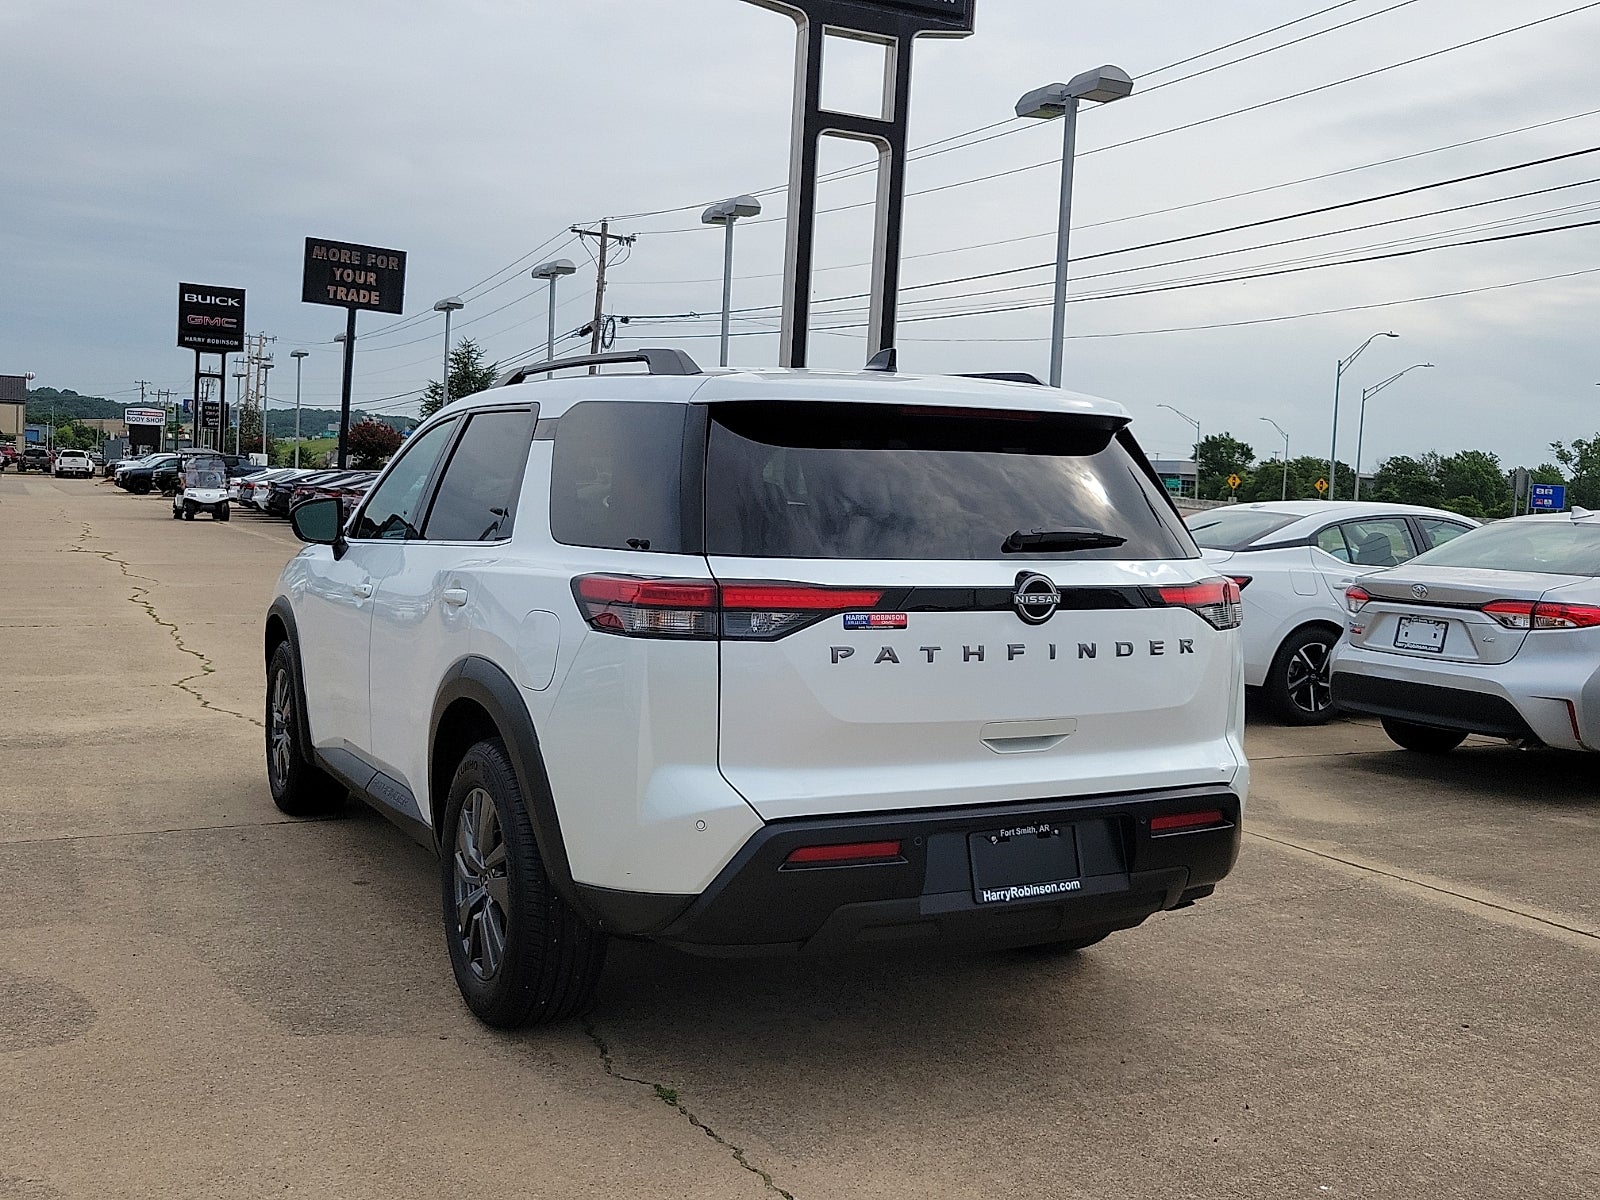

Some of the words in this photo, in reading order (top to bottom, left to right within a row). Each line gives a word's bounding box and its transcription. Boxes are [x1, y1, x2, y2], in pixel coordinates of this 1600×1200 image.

[312, 245, 361, 265] MORE
[366, 253, 399, 270] FOR
[332, 267, 377, 286] YOUR
[184, 293, 240, 307] BUICK
[327, 285, 380, 305] TRADE
[187, 314, 238, 329] GMC
[146, 416, 164, 424] SHOP
[1015, 595, 1060, 603] NISSAN
[829, 637, 1195, 665] PATHFINDER
[1000, 827, 1015, 837] Fort
[1016, 825, 1038, 836] Smith,
[1039, 824, 1050, 832] AR
[983, 880, 1081, 902] HarryRobinson.com
